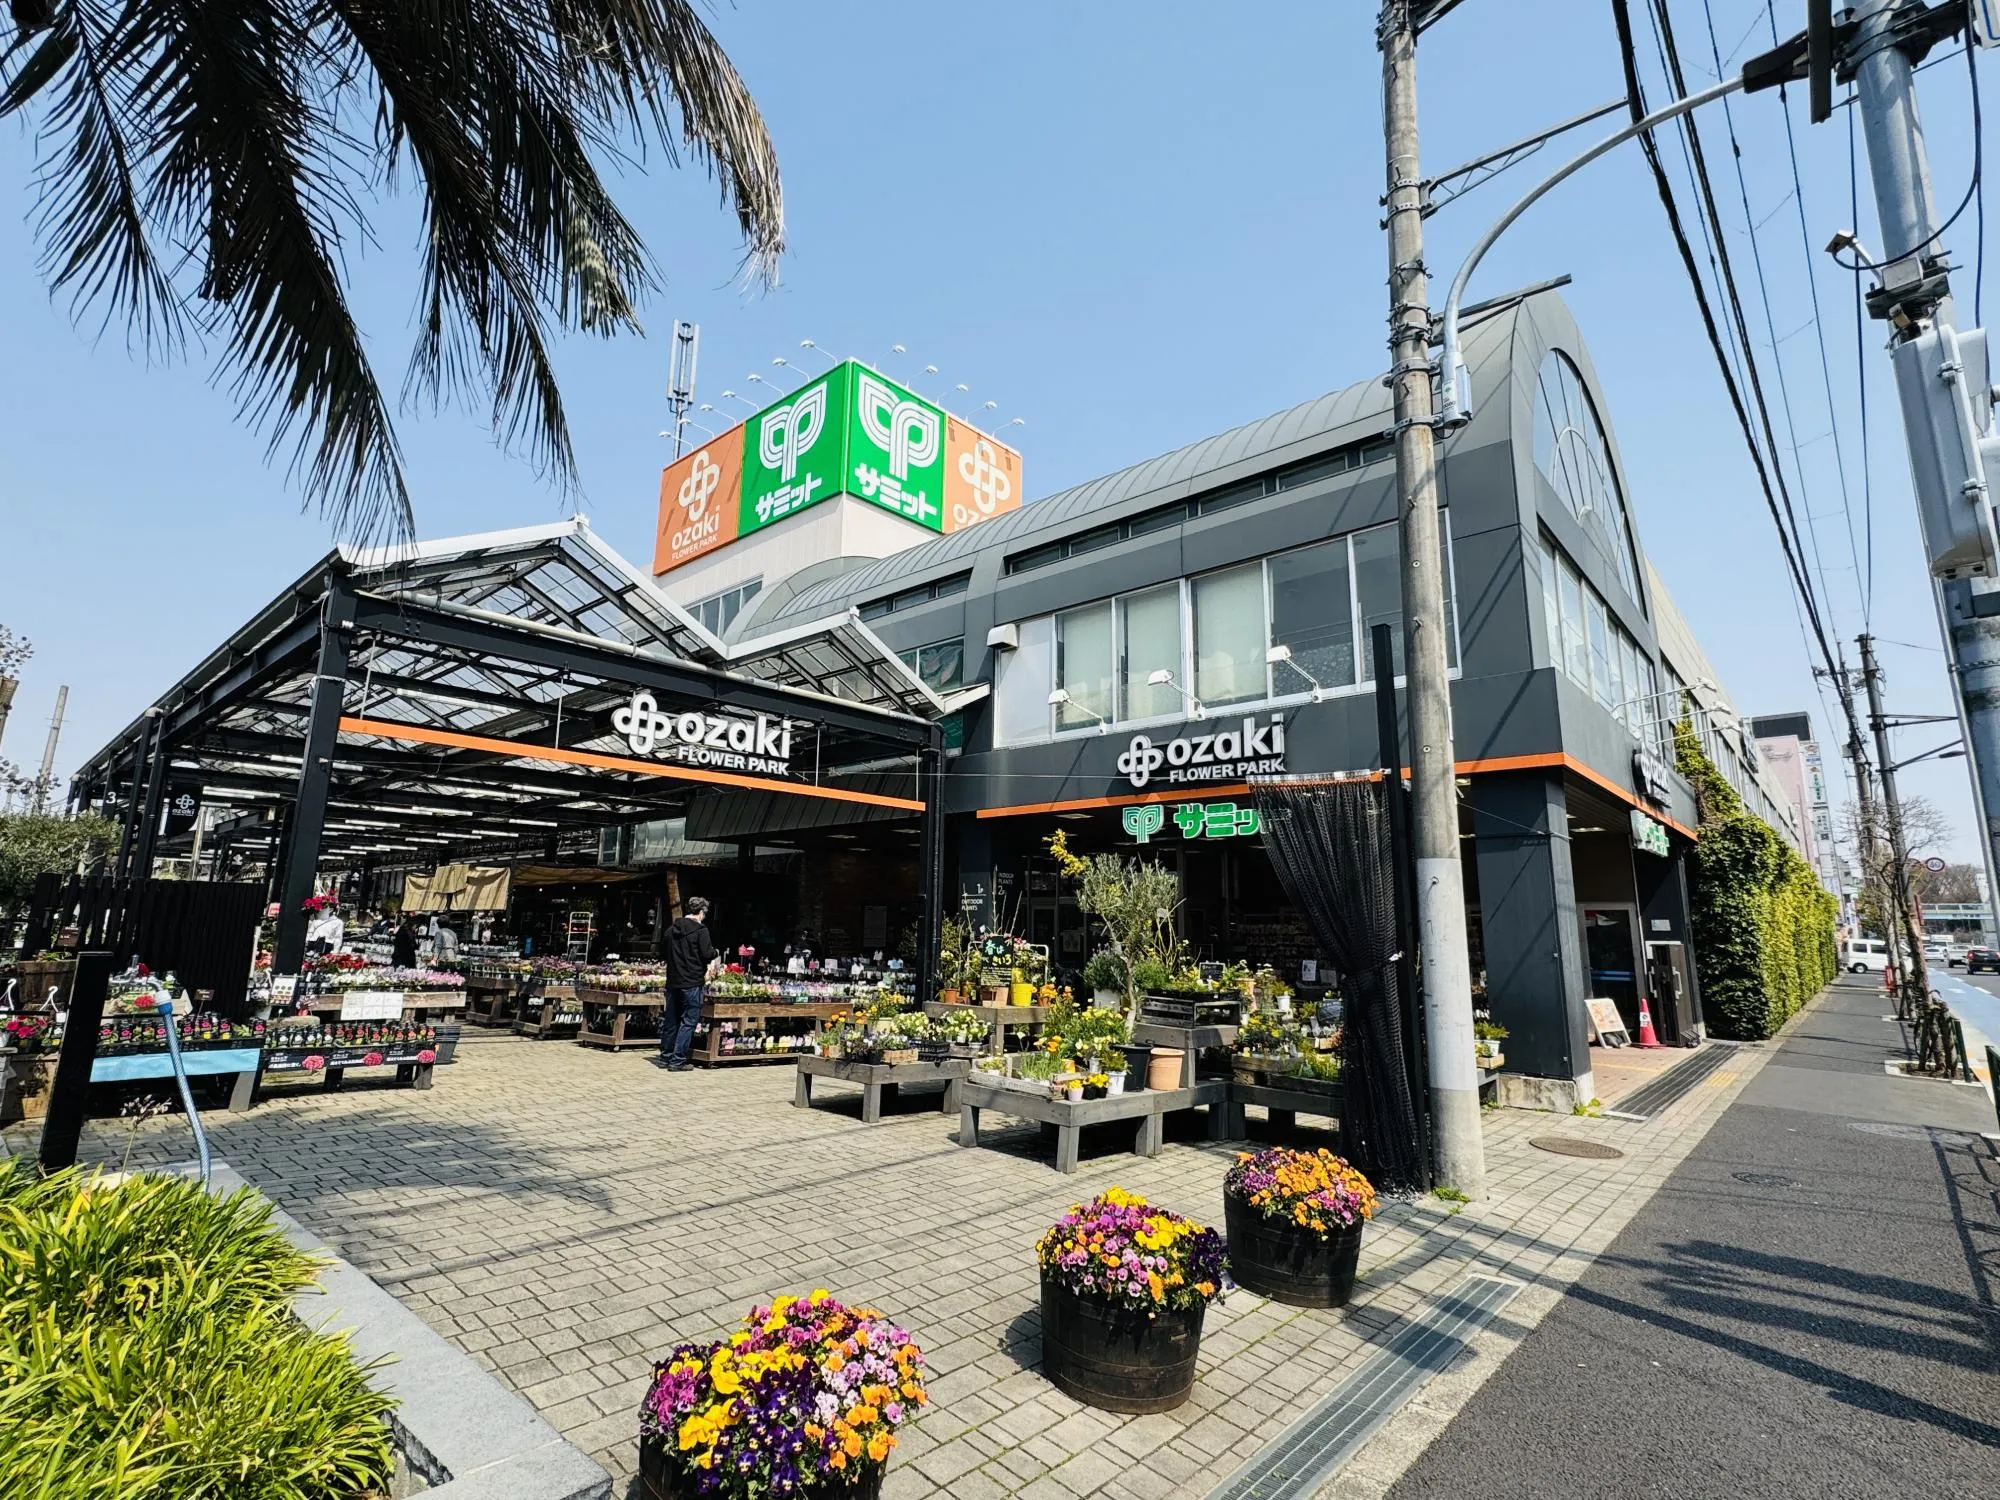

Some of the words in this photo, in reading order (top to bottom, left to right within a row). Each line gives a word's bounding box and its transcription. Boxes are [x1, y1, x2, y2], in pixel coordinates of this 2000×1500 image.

[755, 472, 822, 523] サミット
[854, 462, 937, 521] サミット
[671, 504, 720, 551] ozaki
[671, 543, 698, 561] FLOWER
[700, 534, 718, 548] PARK
[678, 712, 792, 759] ozaki
[1166, 712, 1285, 766] ozaki
[677, 745, 745, 769] FLOWER
[748, 756, 790, 776] PARK
[1169, 763, 1235, 783] FLOWER
[1236, 757, 1287, 776] PARK
[105, 791, 116, 804] 3
